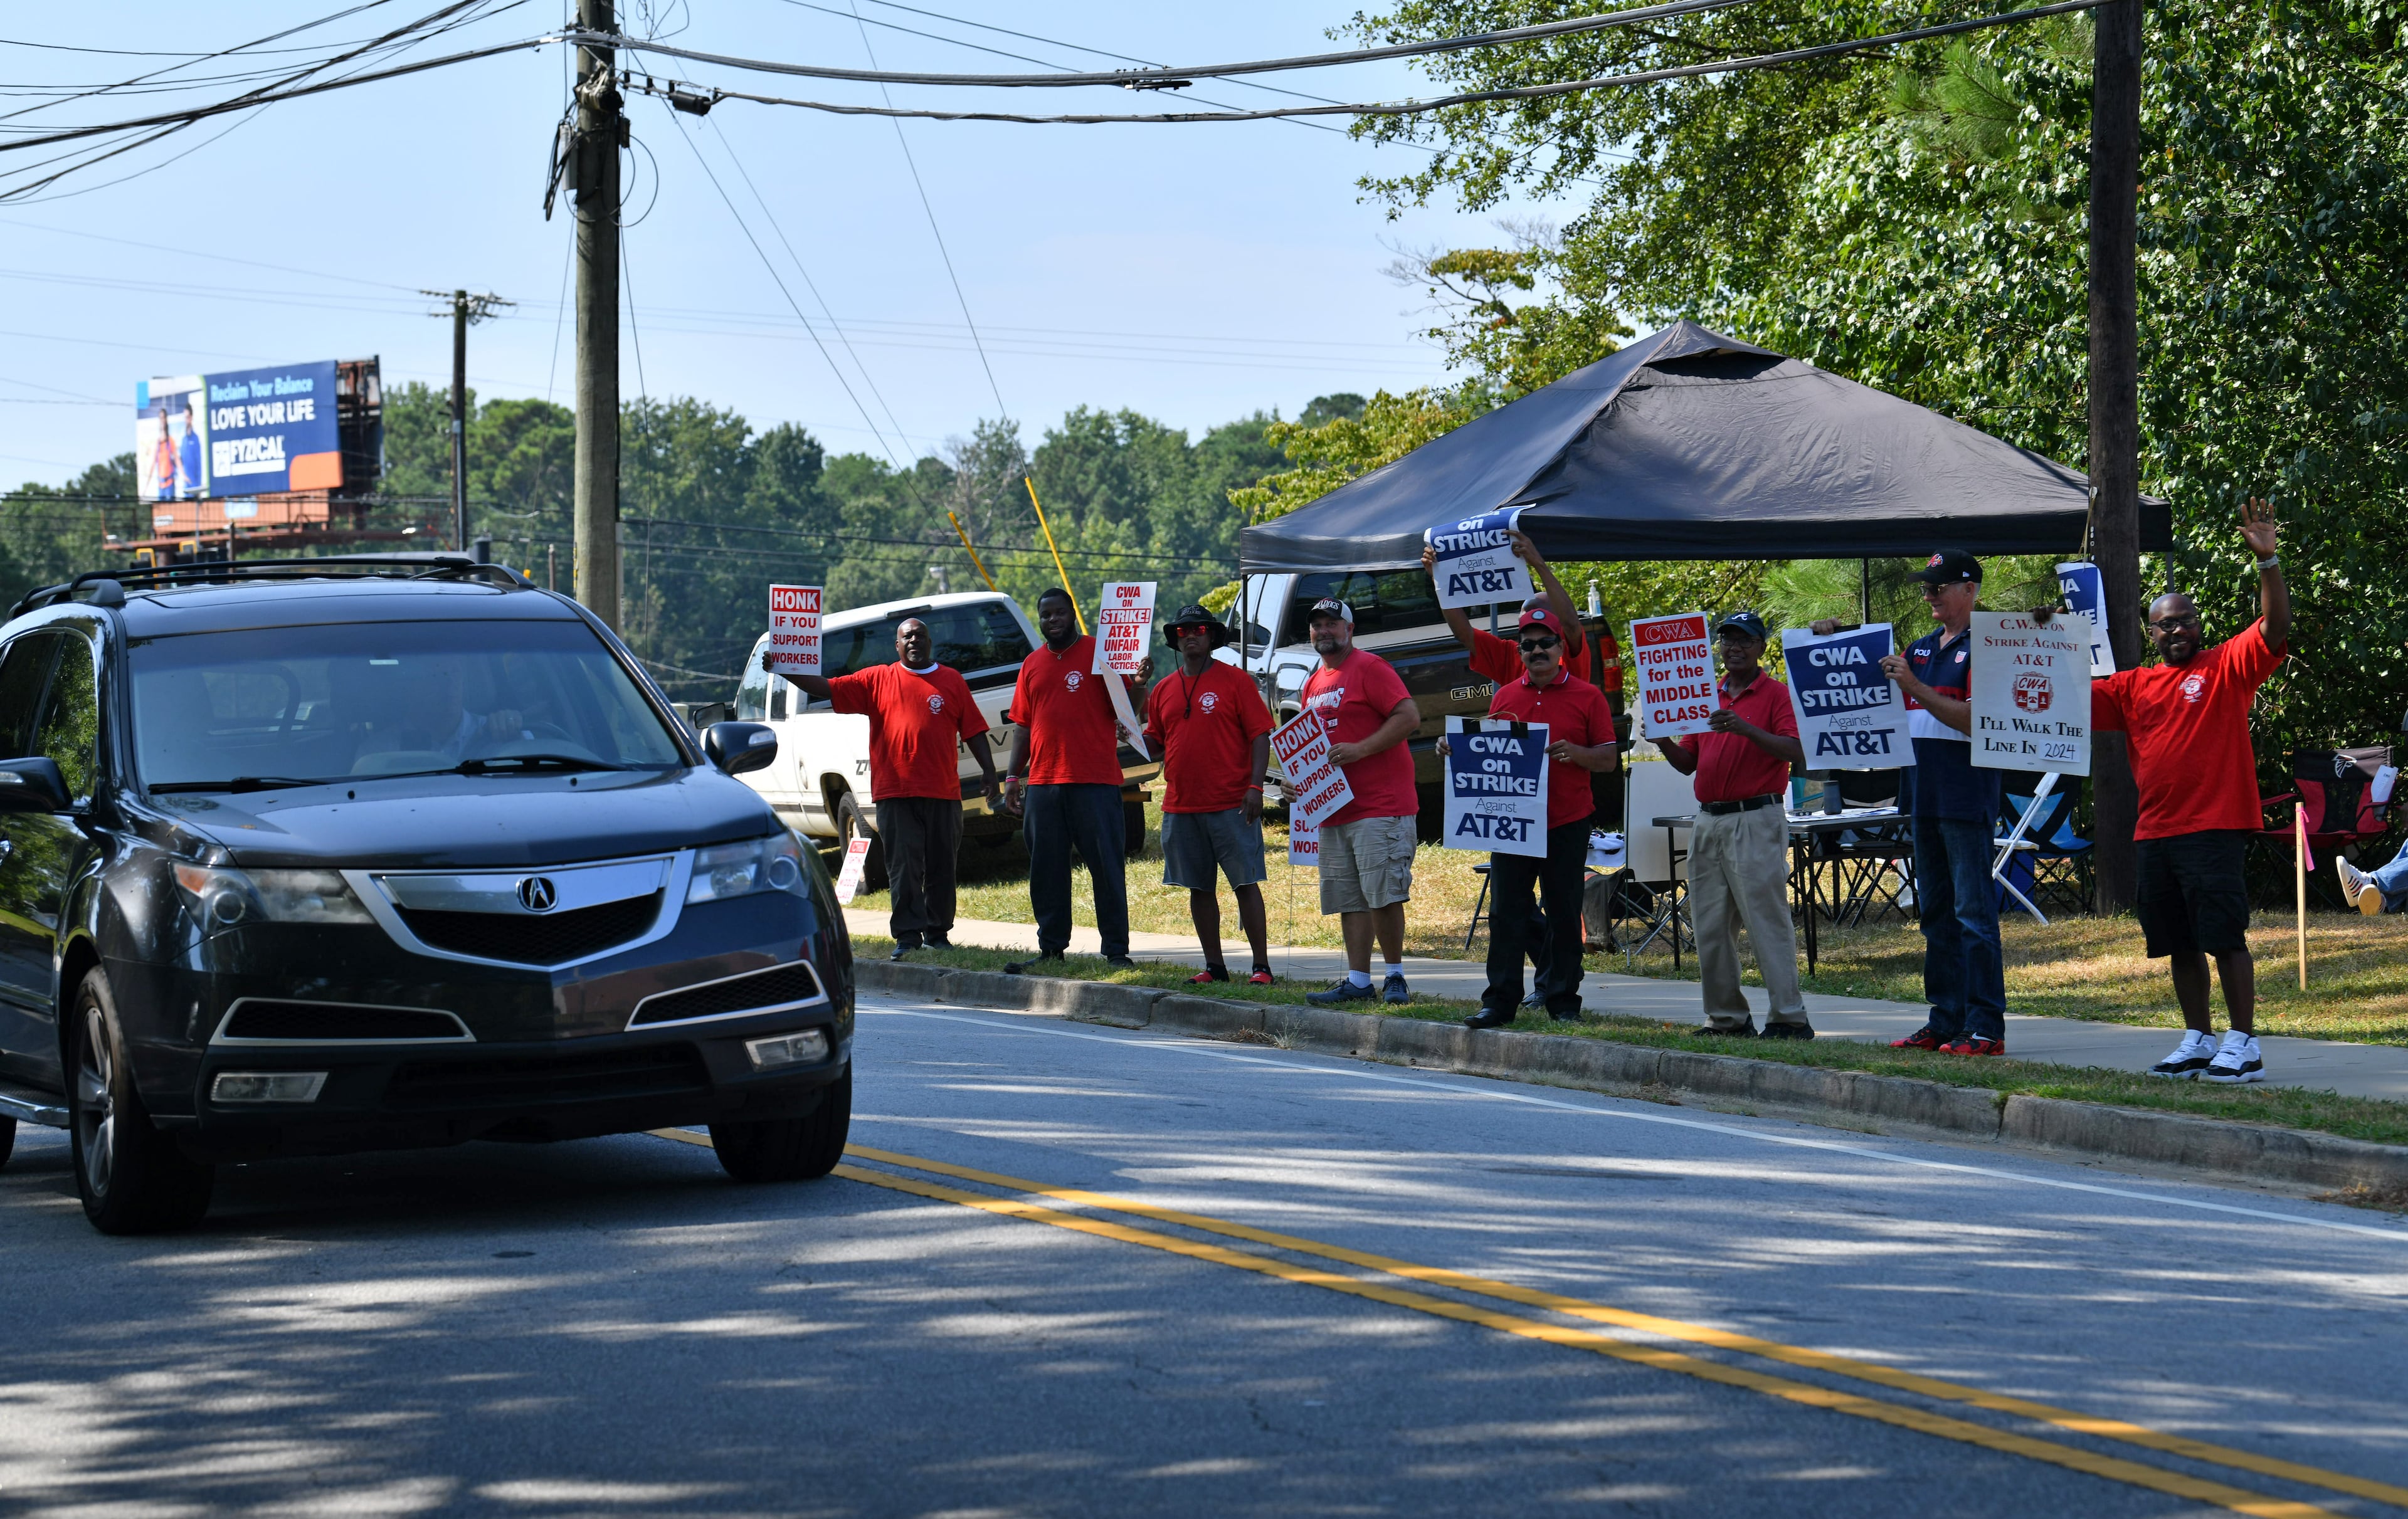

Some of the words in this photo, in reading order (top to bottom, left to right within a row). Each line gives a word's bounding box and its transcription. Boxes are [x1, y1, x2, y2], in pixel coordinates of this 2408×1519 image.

[211, 382, 248, 402] Reclaim
[249, 379, 273, 397] Your
[275, 375, 314, 395] Balance
[211, 406, 246, 431] LOVE
[246, 402, 285, 426] YOUR
[231, 435, 286, 463] FYZICAL
[1457, 518, 1484, 531] on
[1434, 528, 1509, 552] STRIKE
[1458, 555, 1496, 571] Against
[1448, 567, 1515, 596] AT&T
[773, 591, 818, 610] HONK
[1116, 586, 1141, 598] CWA
[775, 616, 786, 626] IF
[790, 617, 816, 628] YOU
[1102, 609, 1150, 623] STRIKE!
[1108, 625, 1139, 638] AT&T
[1645, 622, 1696, 642] CWA
[2000, 619, 2047, 630] C.W.A.
[2051, 623, 2065, 632] ON
[773, 634, 818, 646] SUPPORT
[1104, 639, 1139, 651] UNFAIR
[1984, 636, 2028, 647] STRIKE
[772, 652, 818, 665] WORKERS
[1108, 653, 1133, 661] LABOR
[1639, 644, 1707, 665] FIGHTING
[1809, 646, 1867, 667] CWA
[2012, 654, 2054, 667] AT&T
[1648, 668, 1671, 683] for
[1677, 665, 1704, 679] the
[1825, 671, 1857, 686] on
[2019, 677, 2047, 690] CWA
[1646, 683, 1711, 704] MIDDLE
[1802, 686, 1890, 707] STRIKE
[1654, 704, 1710, 724] CLASS
[1829, 714, 1873, 730] Against
[1275, 714, 1319, 759] HONK
[2011, 718, 2051, 734] WALK
[2056, 722, 2083, 738] THE
[1469, 736, 1524, 756] CWA
[1816, 728, 1895, 756] AT&T
[1983, 737, 2017, 753] LINE
[2021, 740, 2037, 755] IN
[1287, 760, 1299, 777] IF
[1300, 741, 1326, 766] YOU
[2044, 743, 2076, 760] 2024
[1482, 759, 1510, 774] on
[1296, 761, 1336, 797] SUPPORT
[1455, 772, 1536, 796] STRIKE
[1302, 779, 1346, 816] WORKERS
[1475, 797, 1517, 814] Against
[1455, 812, 1534, 842] AT&T
